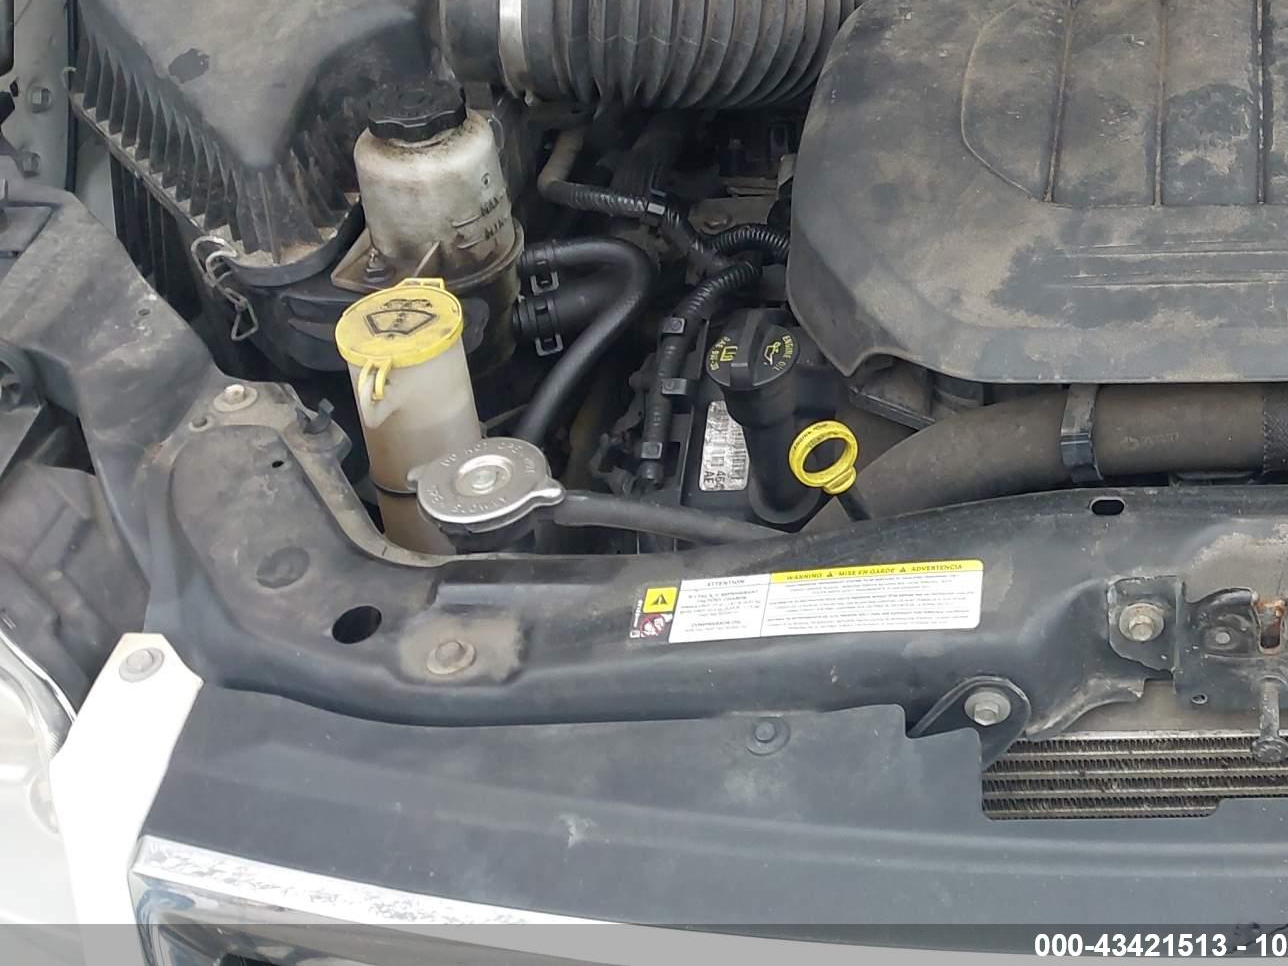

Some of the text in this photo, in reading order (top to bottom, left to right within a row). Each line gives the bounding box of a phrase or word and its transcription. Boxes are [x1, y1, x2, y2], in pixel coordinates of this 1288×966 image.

[772, 334, 794, 372] ENGINE OIL
[786, 572, 823, 581] WARNING
[910, 564, 963, 573] ADVERTENCIA
